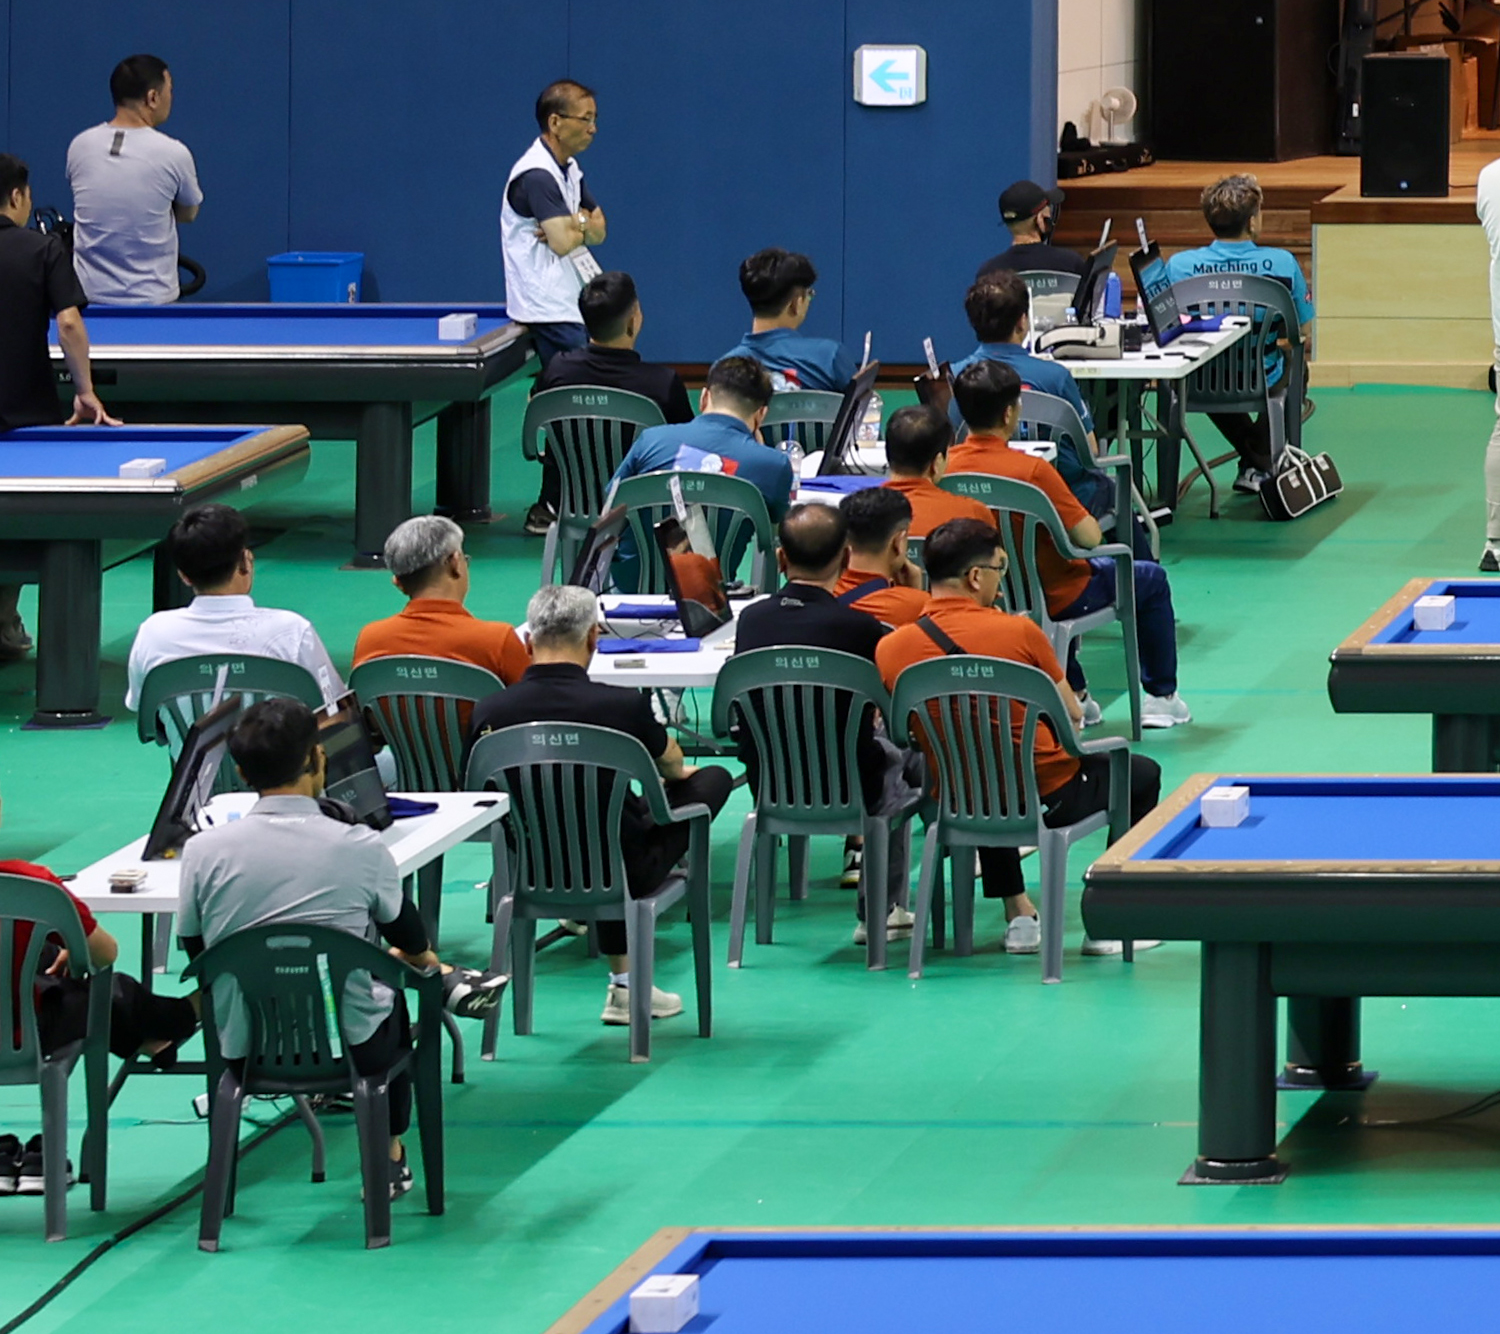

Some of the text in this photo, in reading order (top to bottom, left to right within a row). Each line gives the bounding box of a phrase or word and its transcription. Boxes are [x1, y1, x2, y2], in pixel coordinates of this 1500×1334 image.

[1193, 259, 1273, 275] Matching Q
[200, 662, 245, 676] 의면
